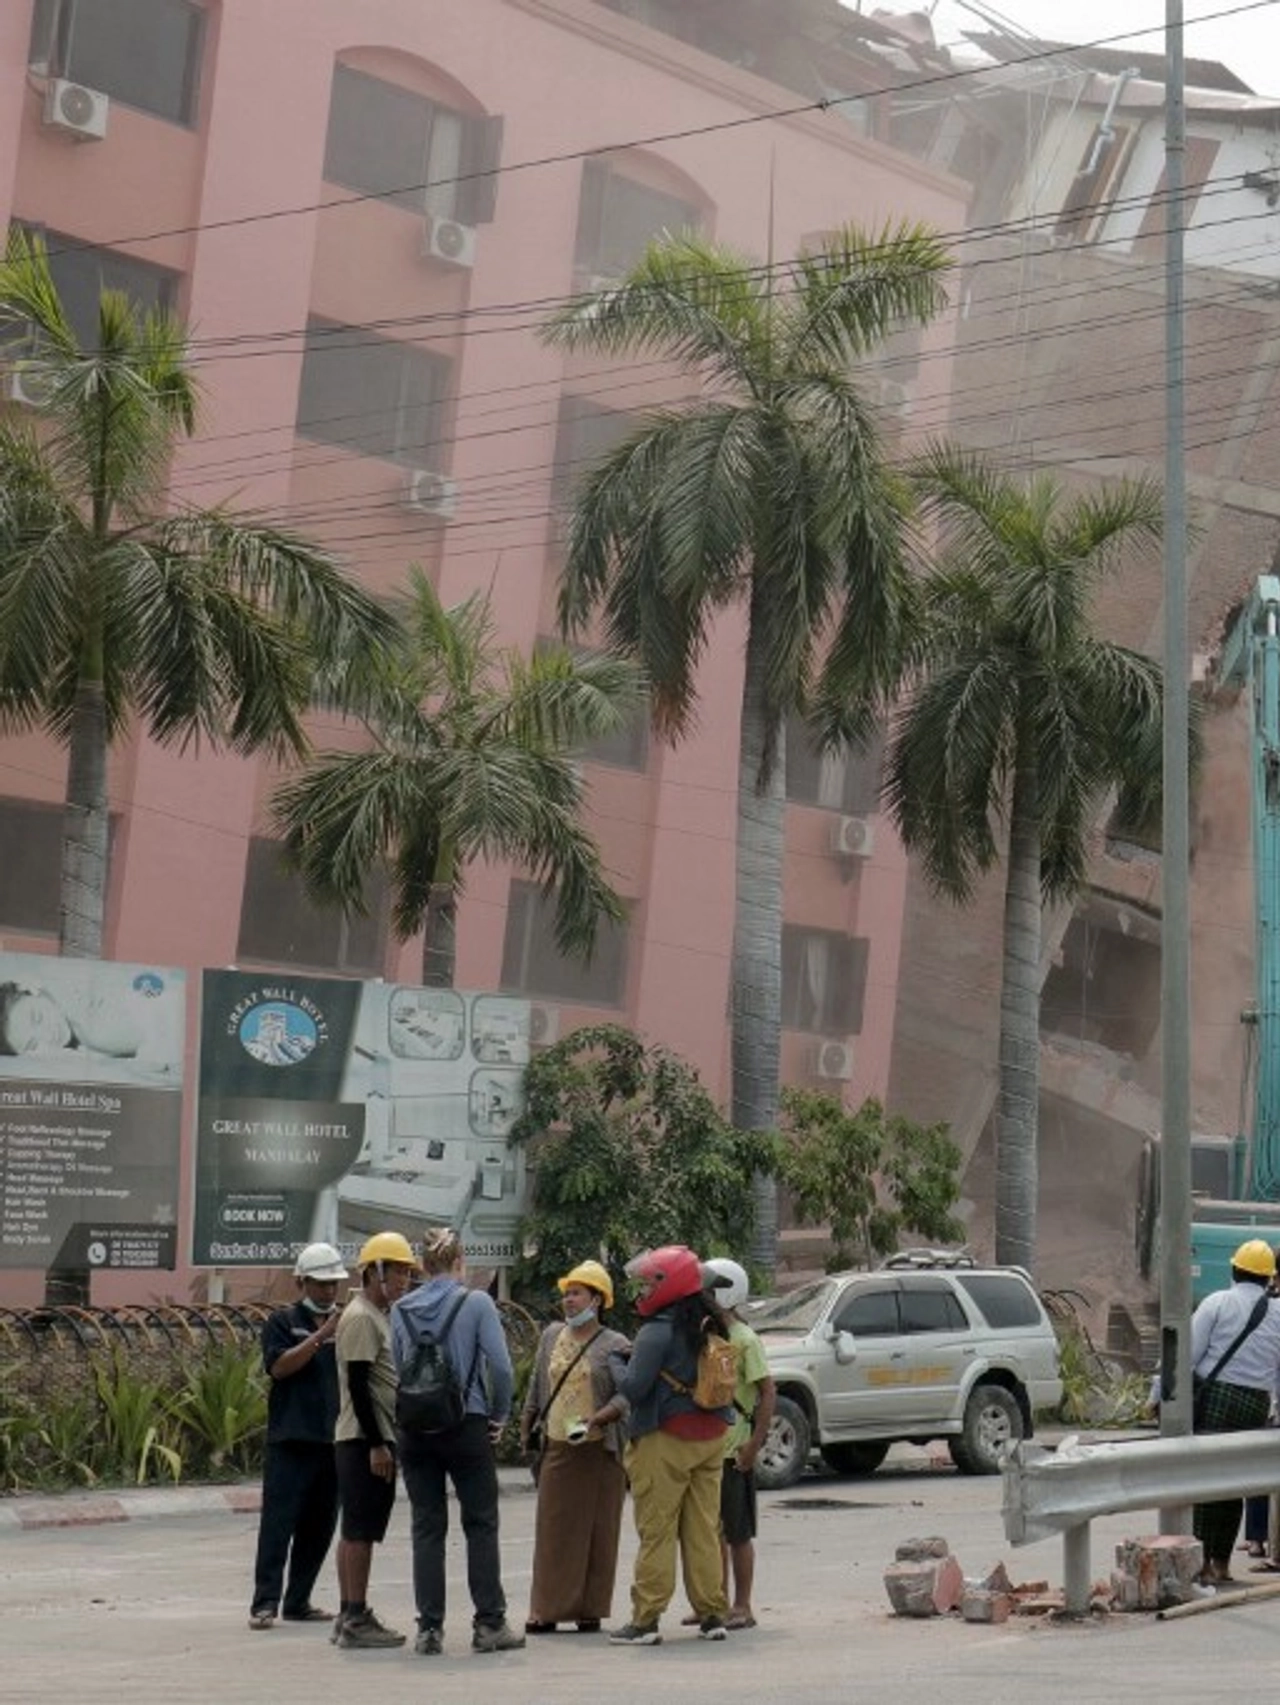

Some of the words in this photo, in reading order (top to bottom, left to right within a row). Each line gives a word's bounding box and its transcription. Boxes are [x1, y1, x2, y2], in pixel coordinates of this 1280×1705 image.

[1, 1092, 27, 1105] reat
[212, 1120, 260, 1135] GREAT
[262, 1122, 298, 1137] WALL
[304, 1123, 350, 1138] HOTEL
[244, 1148, 321, 1164] MANDALAY
[223, 1209, 256, 1222] BOOK
[258, 1209, 285, 1221] NOW
